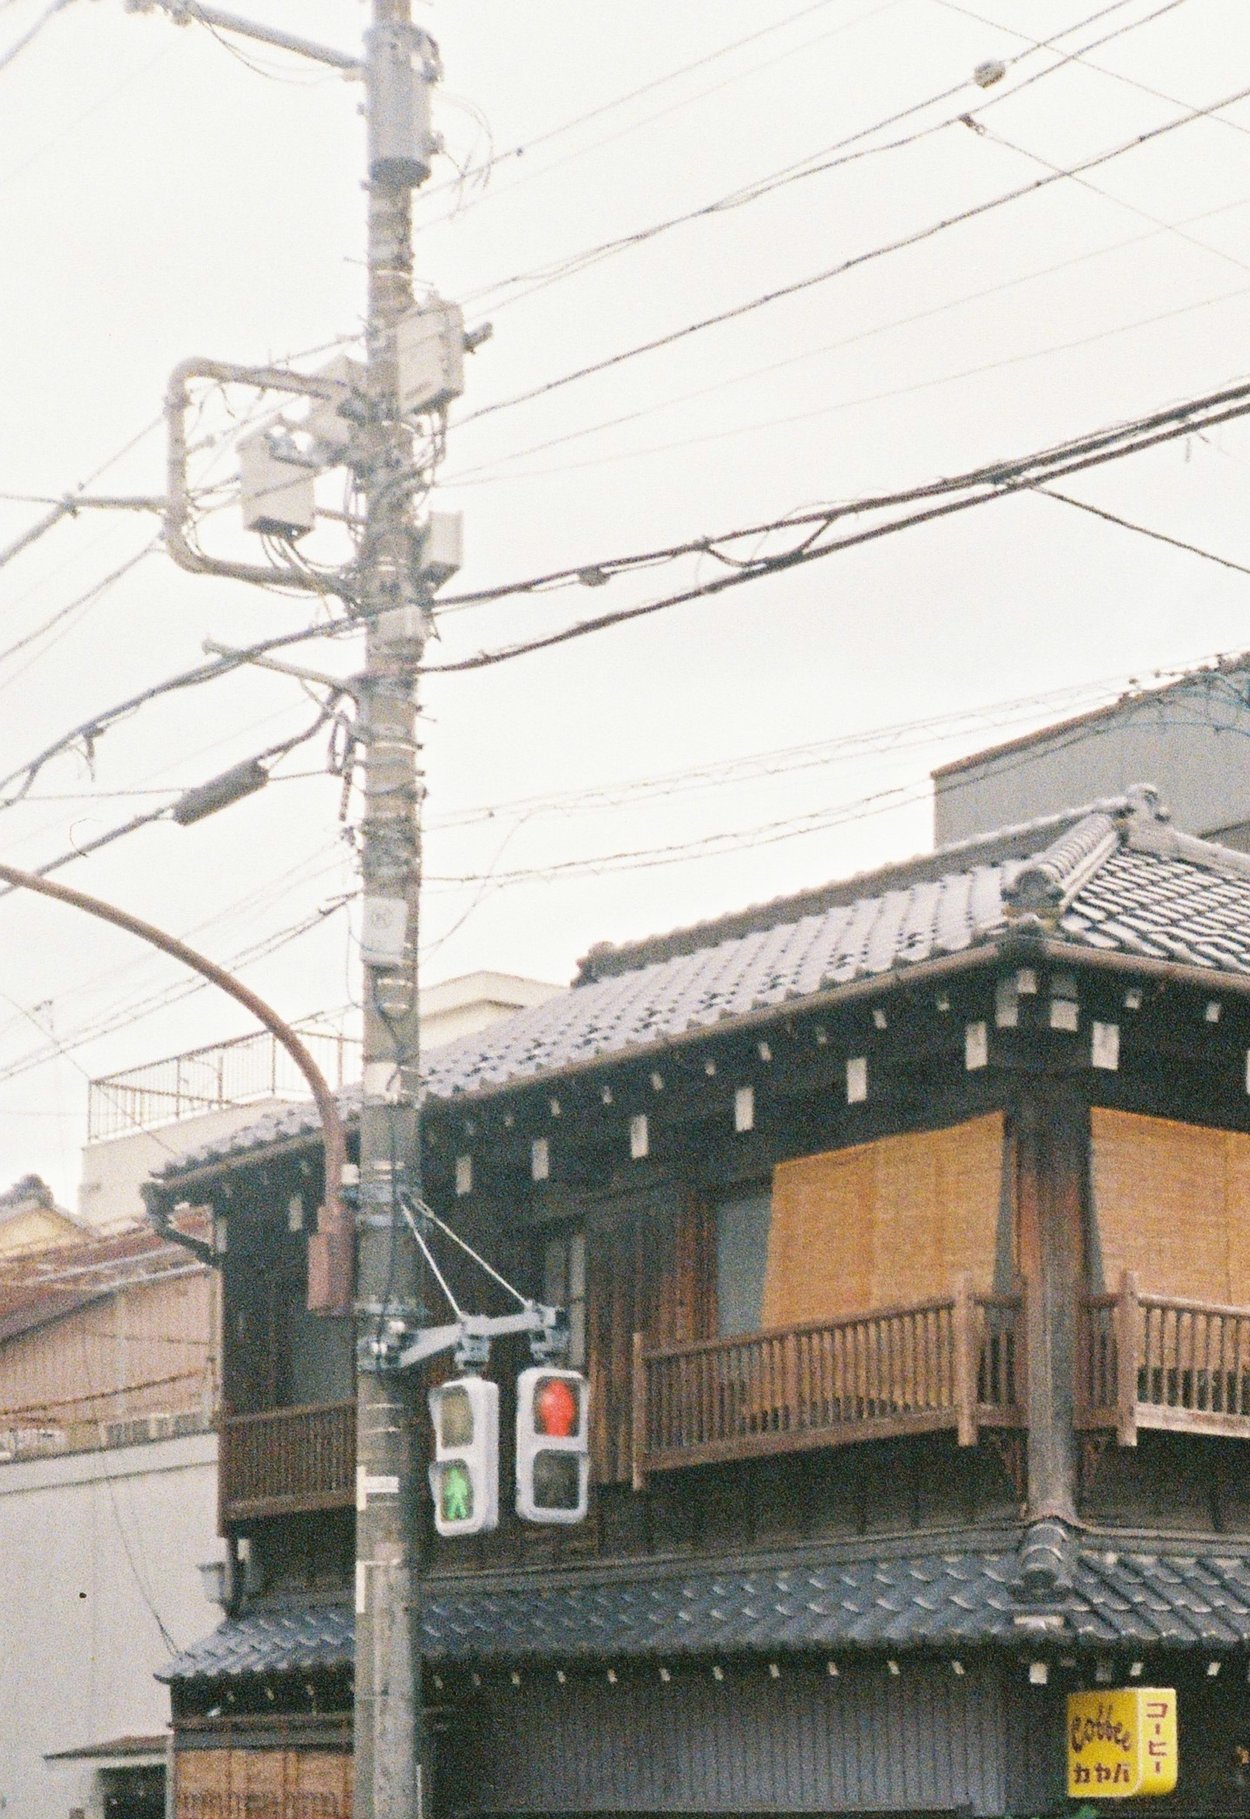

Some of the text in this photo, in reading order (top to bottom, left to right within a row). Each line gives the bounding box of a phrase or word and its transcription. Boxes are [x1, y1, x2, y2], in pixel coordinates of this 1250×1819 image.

[1070, 1702, 1132, 1754] Coffee
[1145, 1702, 1168, 1774] コーヒー
[1073, 1762, 1131, 1784] カヤバ
